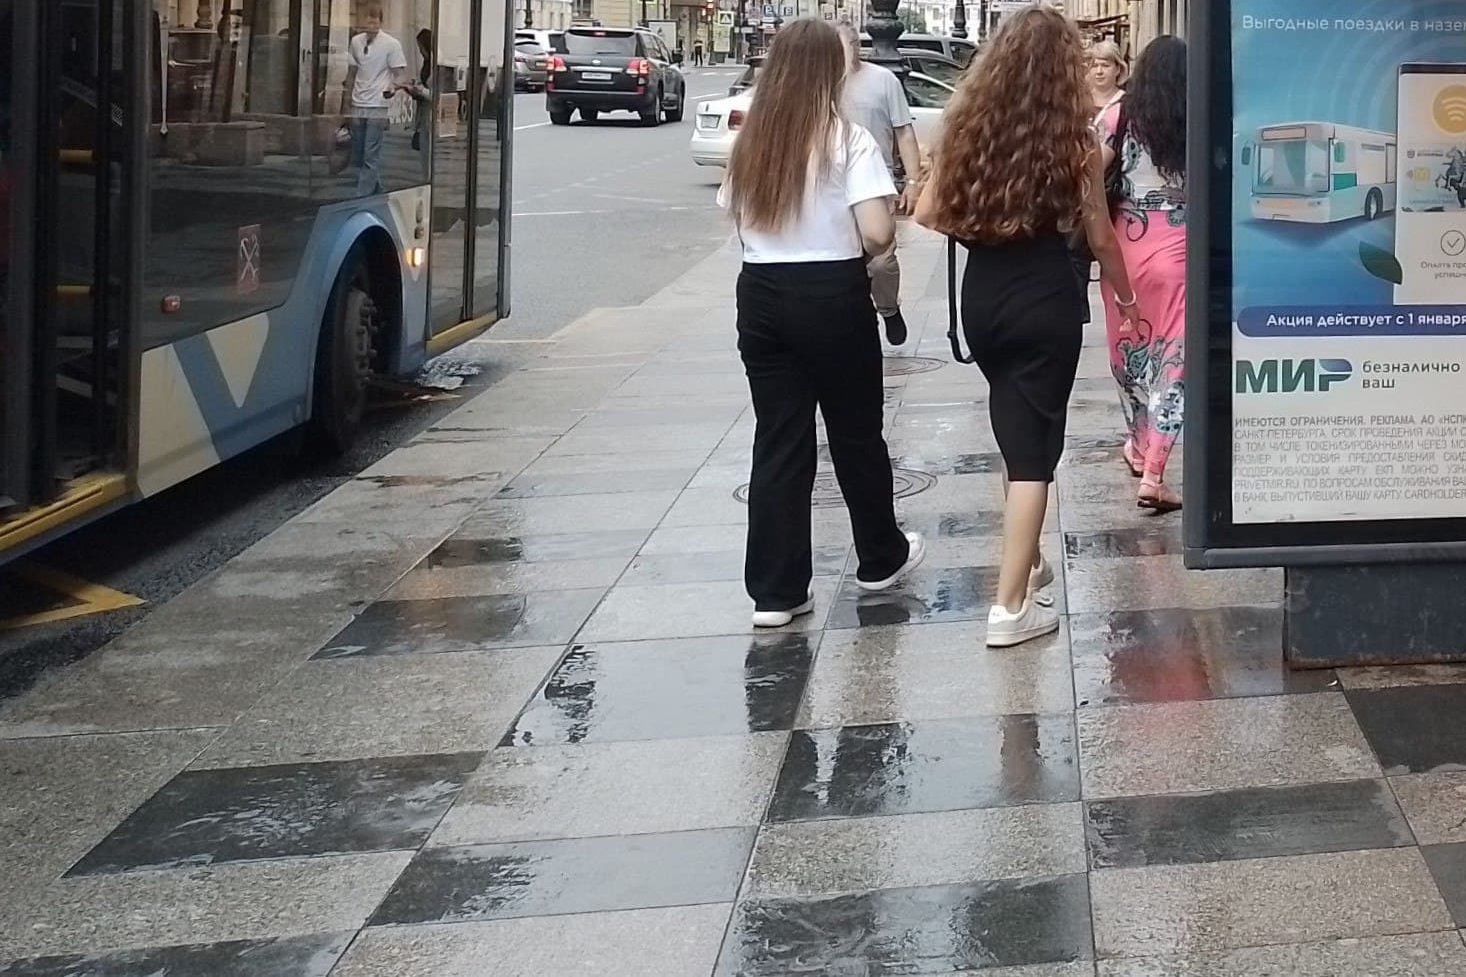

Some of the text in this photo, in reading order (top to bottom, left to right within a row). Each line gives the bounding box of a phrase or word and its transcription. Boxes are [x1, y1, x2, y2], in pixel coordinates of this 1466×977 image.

[1242, 15, 1329, 32] Выгодные
[1335, 17, 1404, 33] поездки
[1410, 20, 1419, 31] в
[1267, 314, 1313, 329] Акция
[1317, 313, 1392, 329] действует
[1396, 315, 1404, 325] с
[1408, 313, 1414, 325] 1
[1362, 359, 1461, 375] безналично
[1235, 358, 1353, 394] МИР
[1362, 377, 1395, 389] ваш
